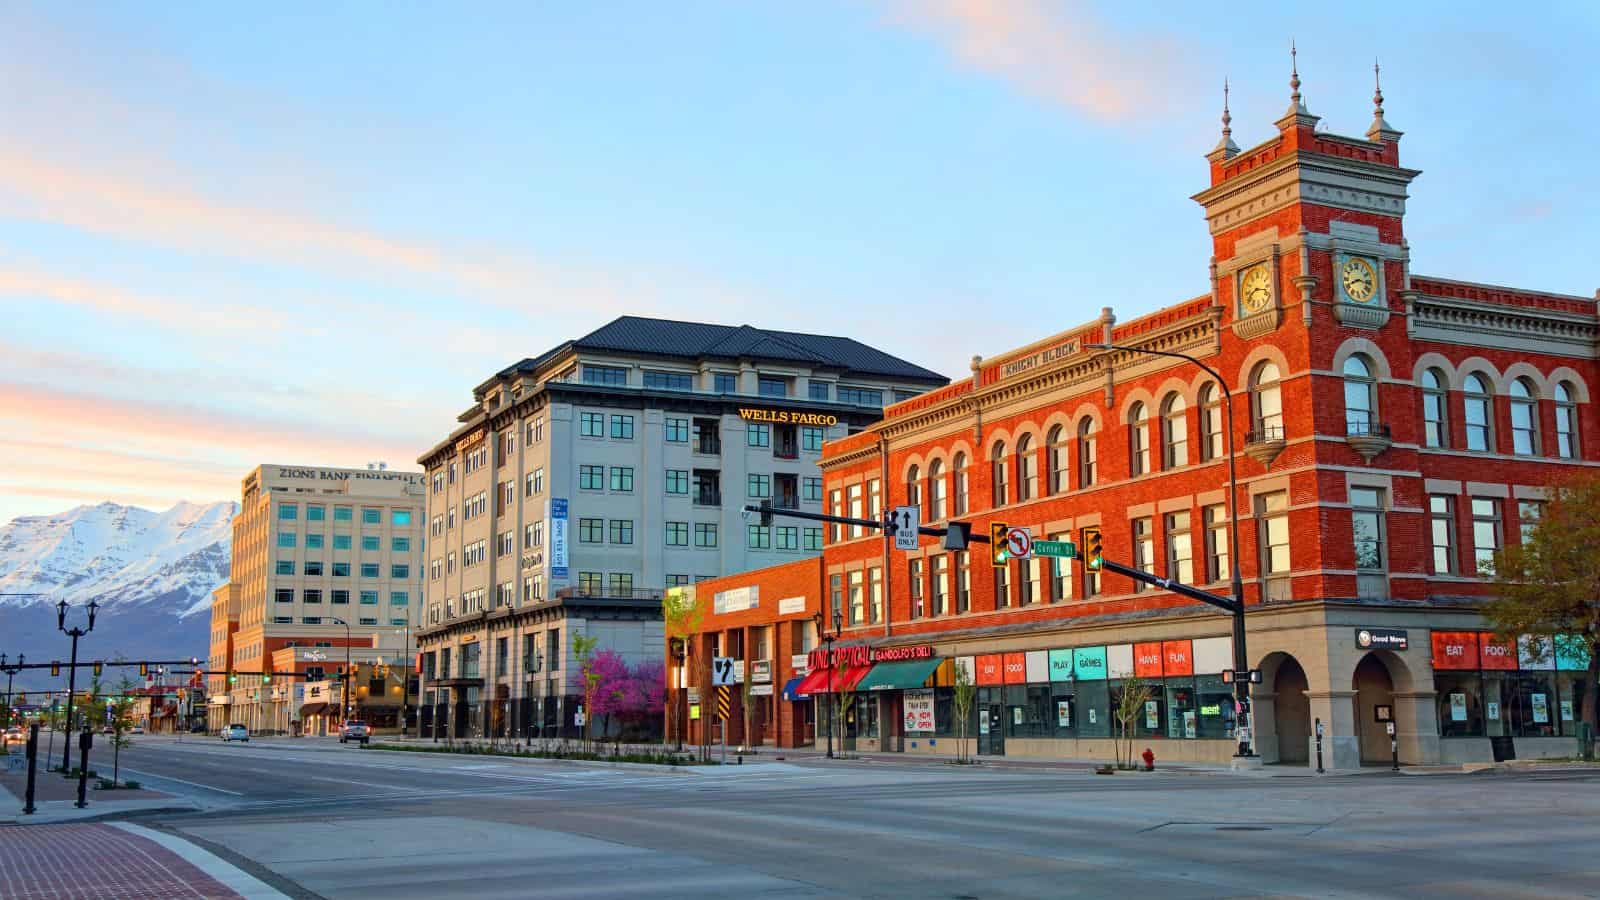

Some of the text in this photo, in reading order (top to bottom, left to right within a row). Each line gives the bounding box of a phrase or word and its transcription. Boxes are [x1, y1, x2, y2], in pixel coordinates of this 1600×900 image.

[1043, 342, 1076, 364] BLOCK
[739, 408, 838, 426] WELLS FARGO
[280, 468, 316, 479] ZIONS
[321, 471, 351, 481] BANK
[898, 538, 914, 546] ONLY
[875, 646, 932, 661] GANDOLFO'S DELI
[1445, 645, 1464, 656] EAT
[833, 645, 871, 668] OPTICAL
[1138, 655, 1158, 665] HAVE
[1169, 653, 1185, 664] FUN
[984, 664, 995, 673] EAT
[1006, 663, 1023, 673] FOOD
[1053, 660, 1068, 670] PLAY
[1079, 658, 1102, 669] GAMES
